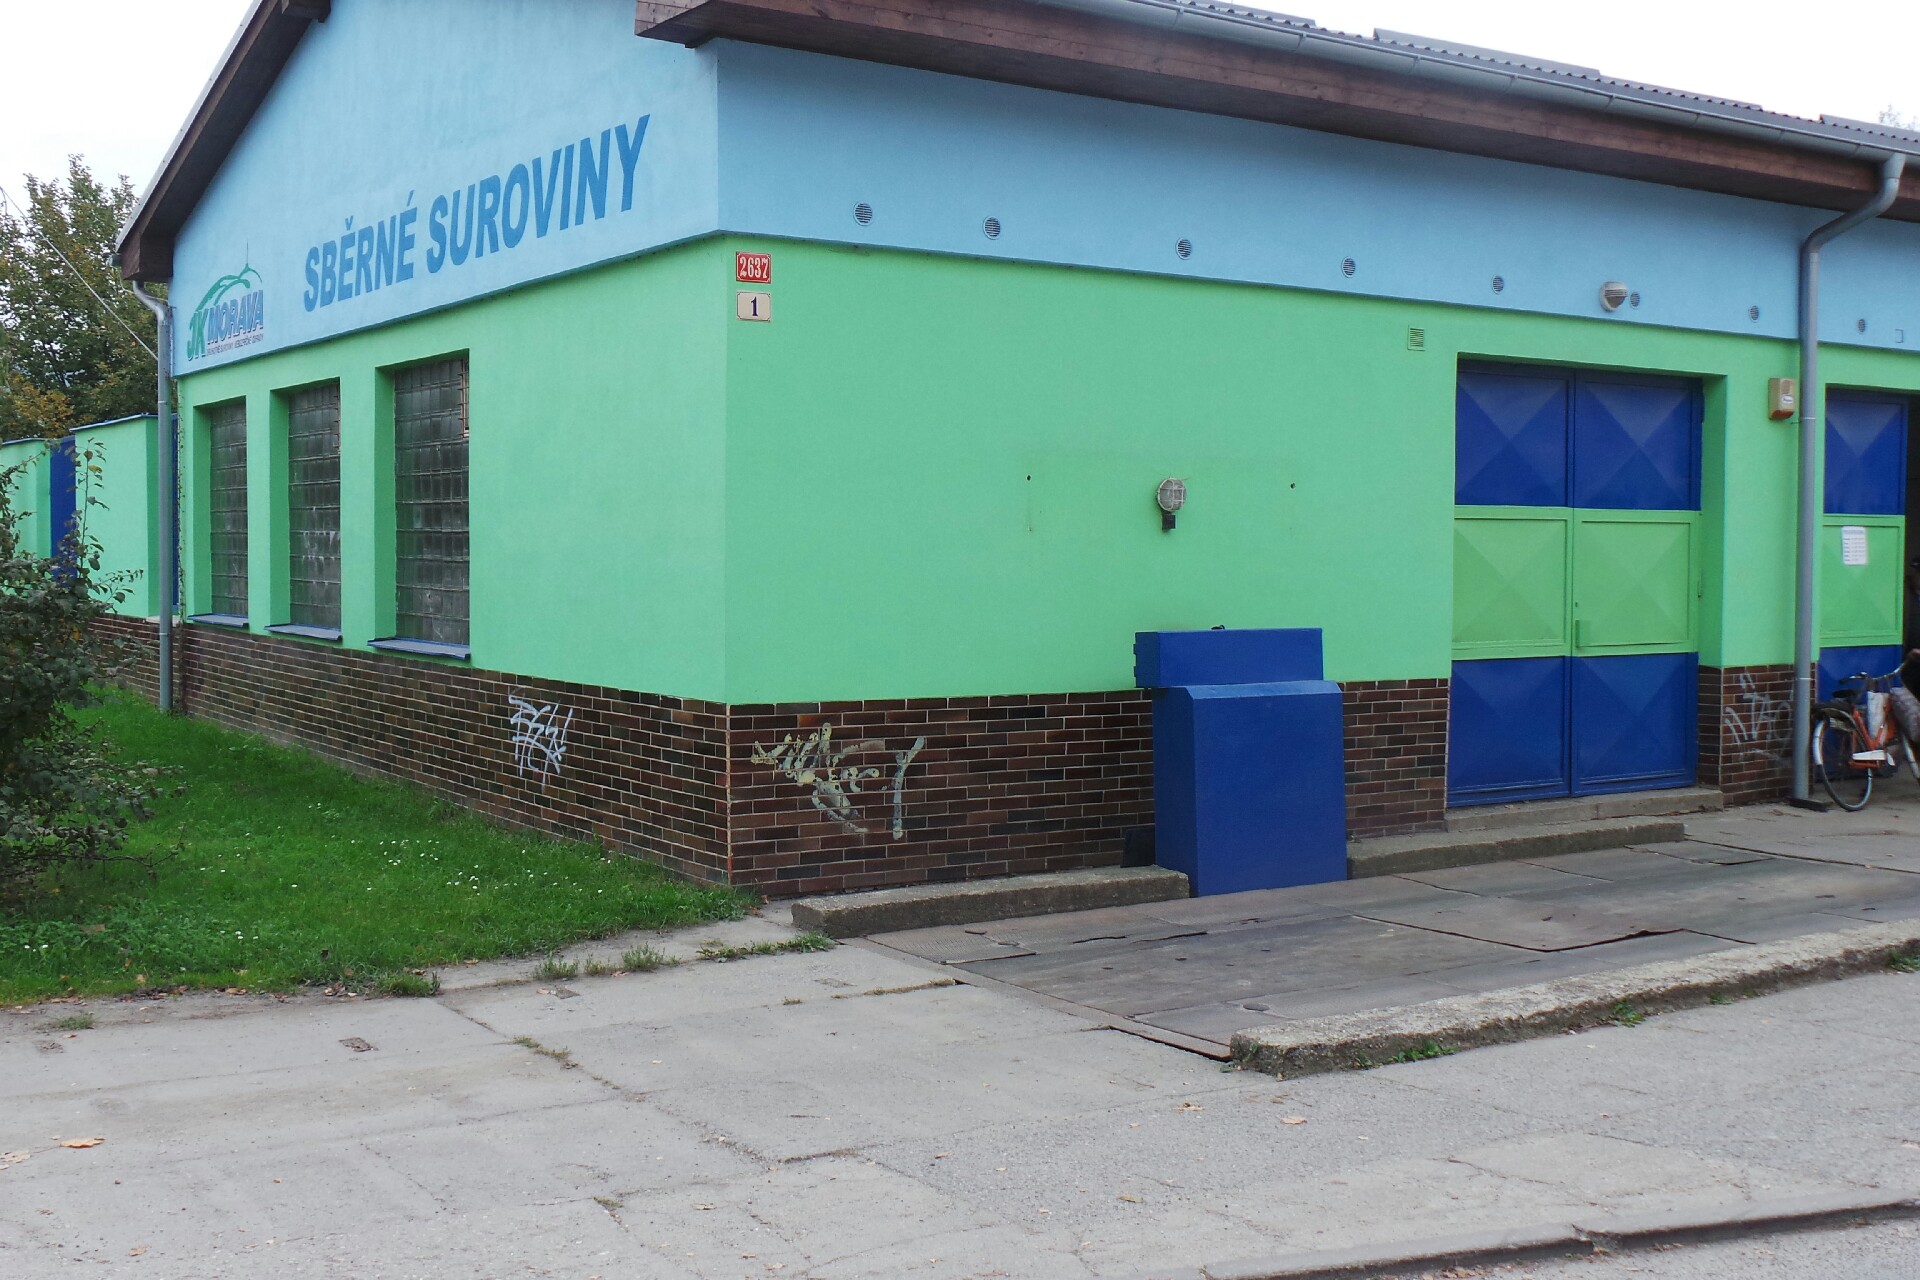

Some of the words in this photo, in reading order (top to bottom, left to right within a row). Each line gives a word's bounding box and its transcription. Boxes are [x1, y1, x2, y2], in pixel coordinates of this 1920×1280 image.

[303, 190, 418, 313] SBĚRNÉ
[426, 114, 651, 274] SUROVINY
[740, 257, 769, 278] 2637
[187, 308, 209, 361] JK
[207, 289, 264, 345] MORAVA
[751, 297, 758, 316] 1
